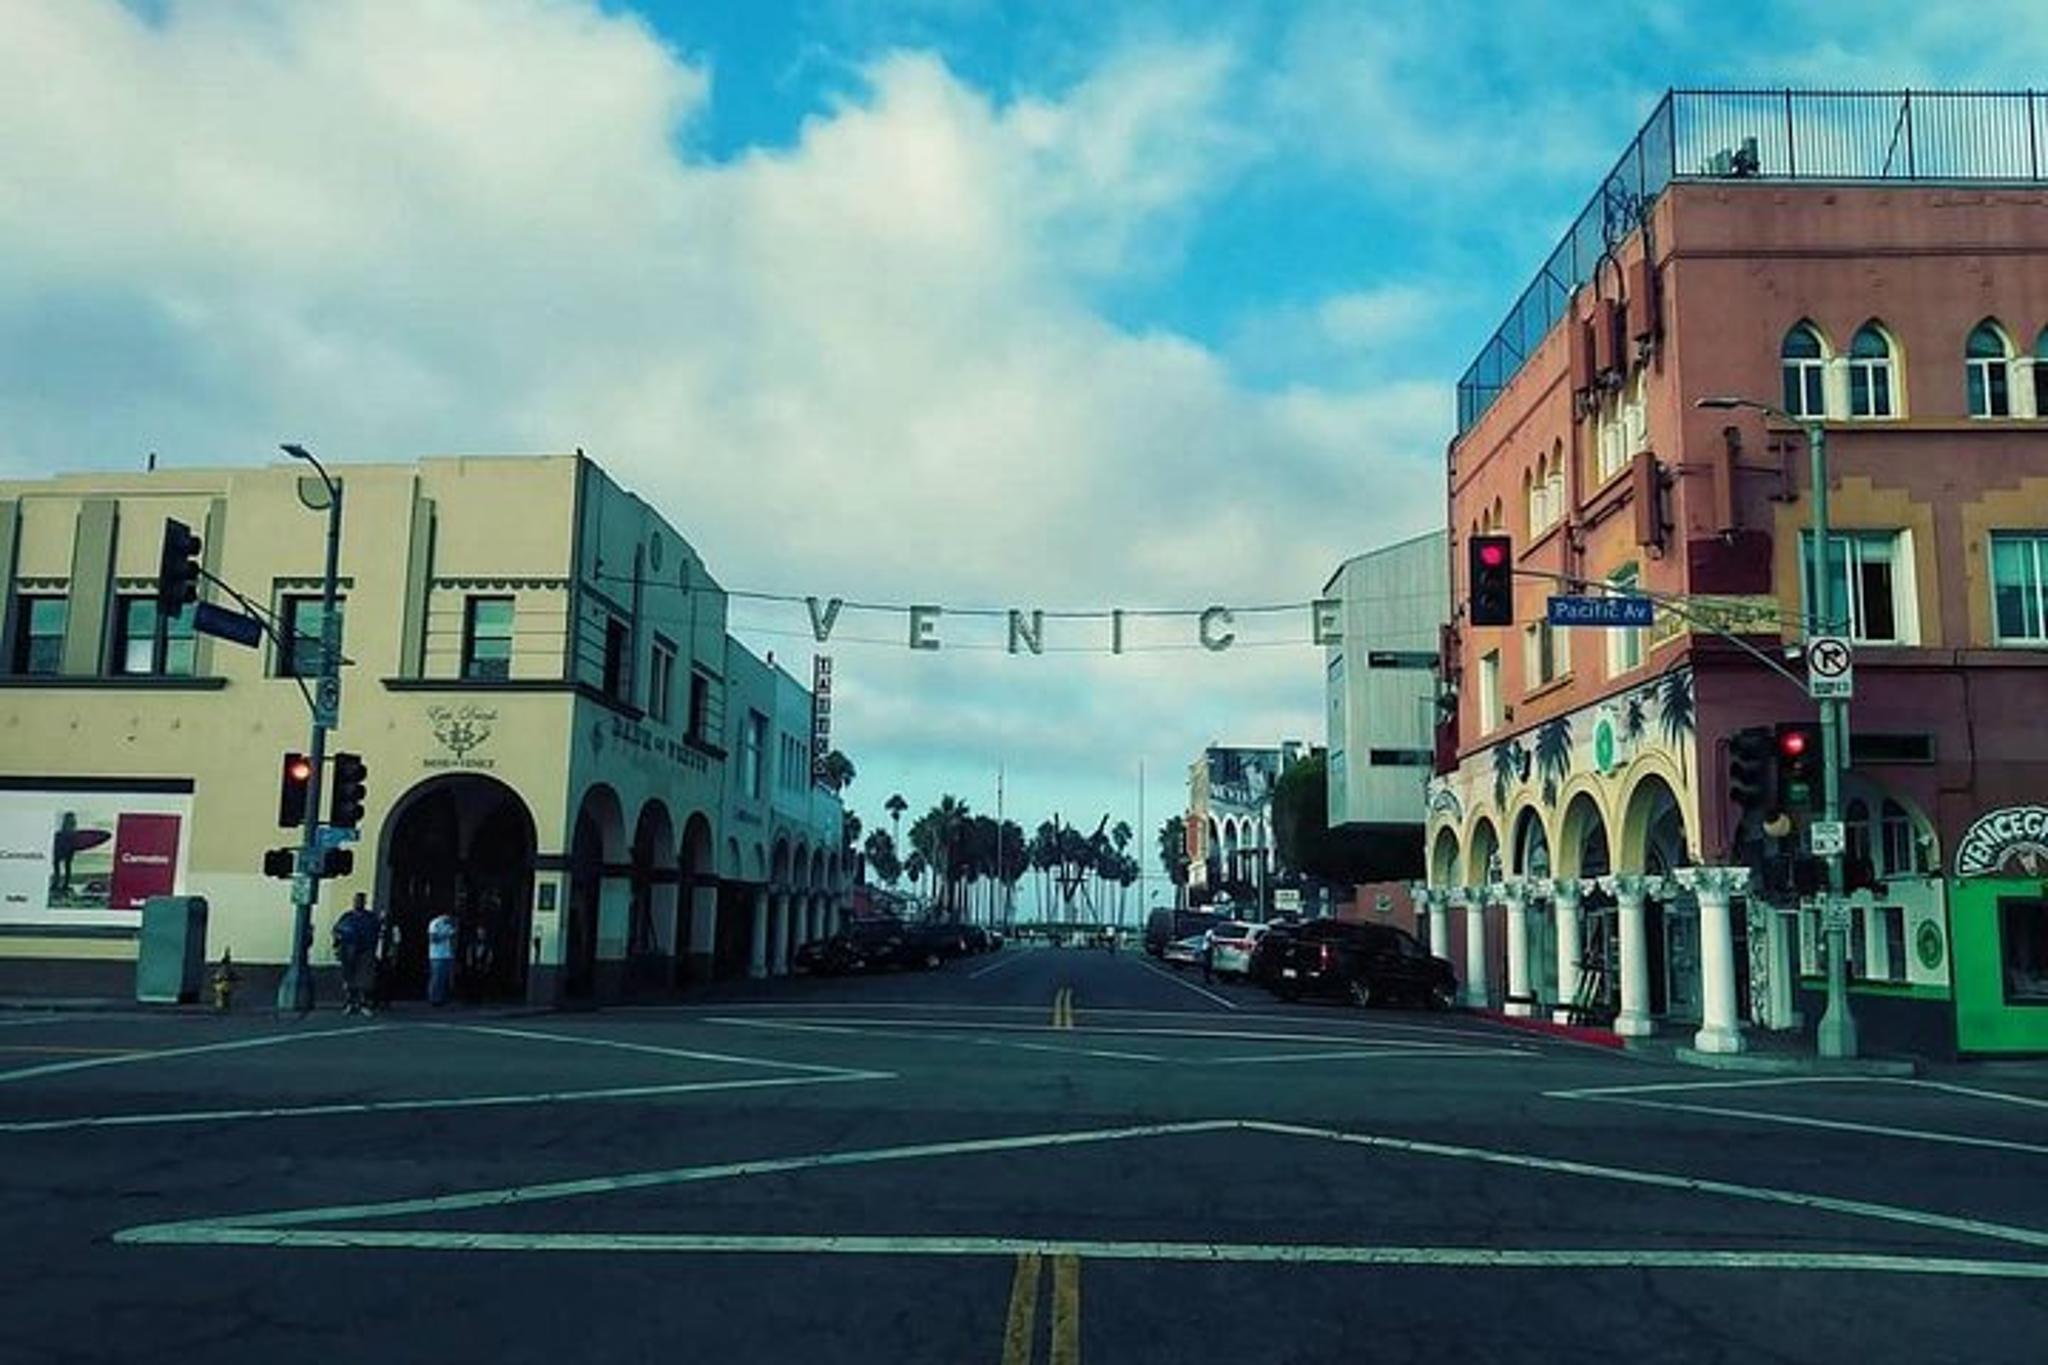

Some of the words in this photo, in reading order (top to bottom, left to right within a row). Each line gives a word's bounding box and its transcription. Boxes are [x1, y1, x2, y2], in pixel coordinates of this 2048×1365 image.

[805, 597, 1343, 655] VENICE
[1555, 601, 1620, 618] Pacific
[1624, 603, 1646, 618] Av
